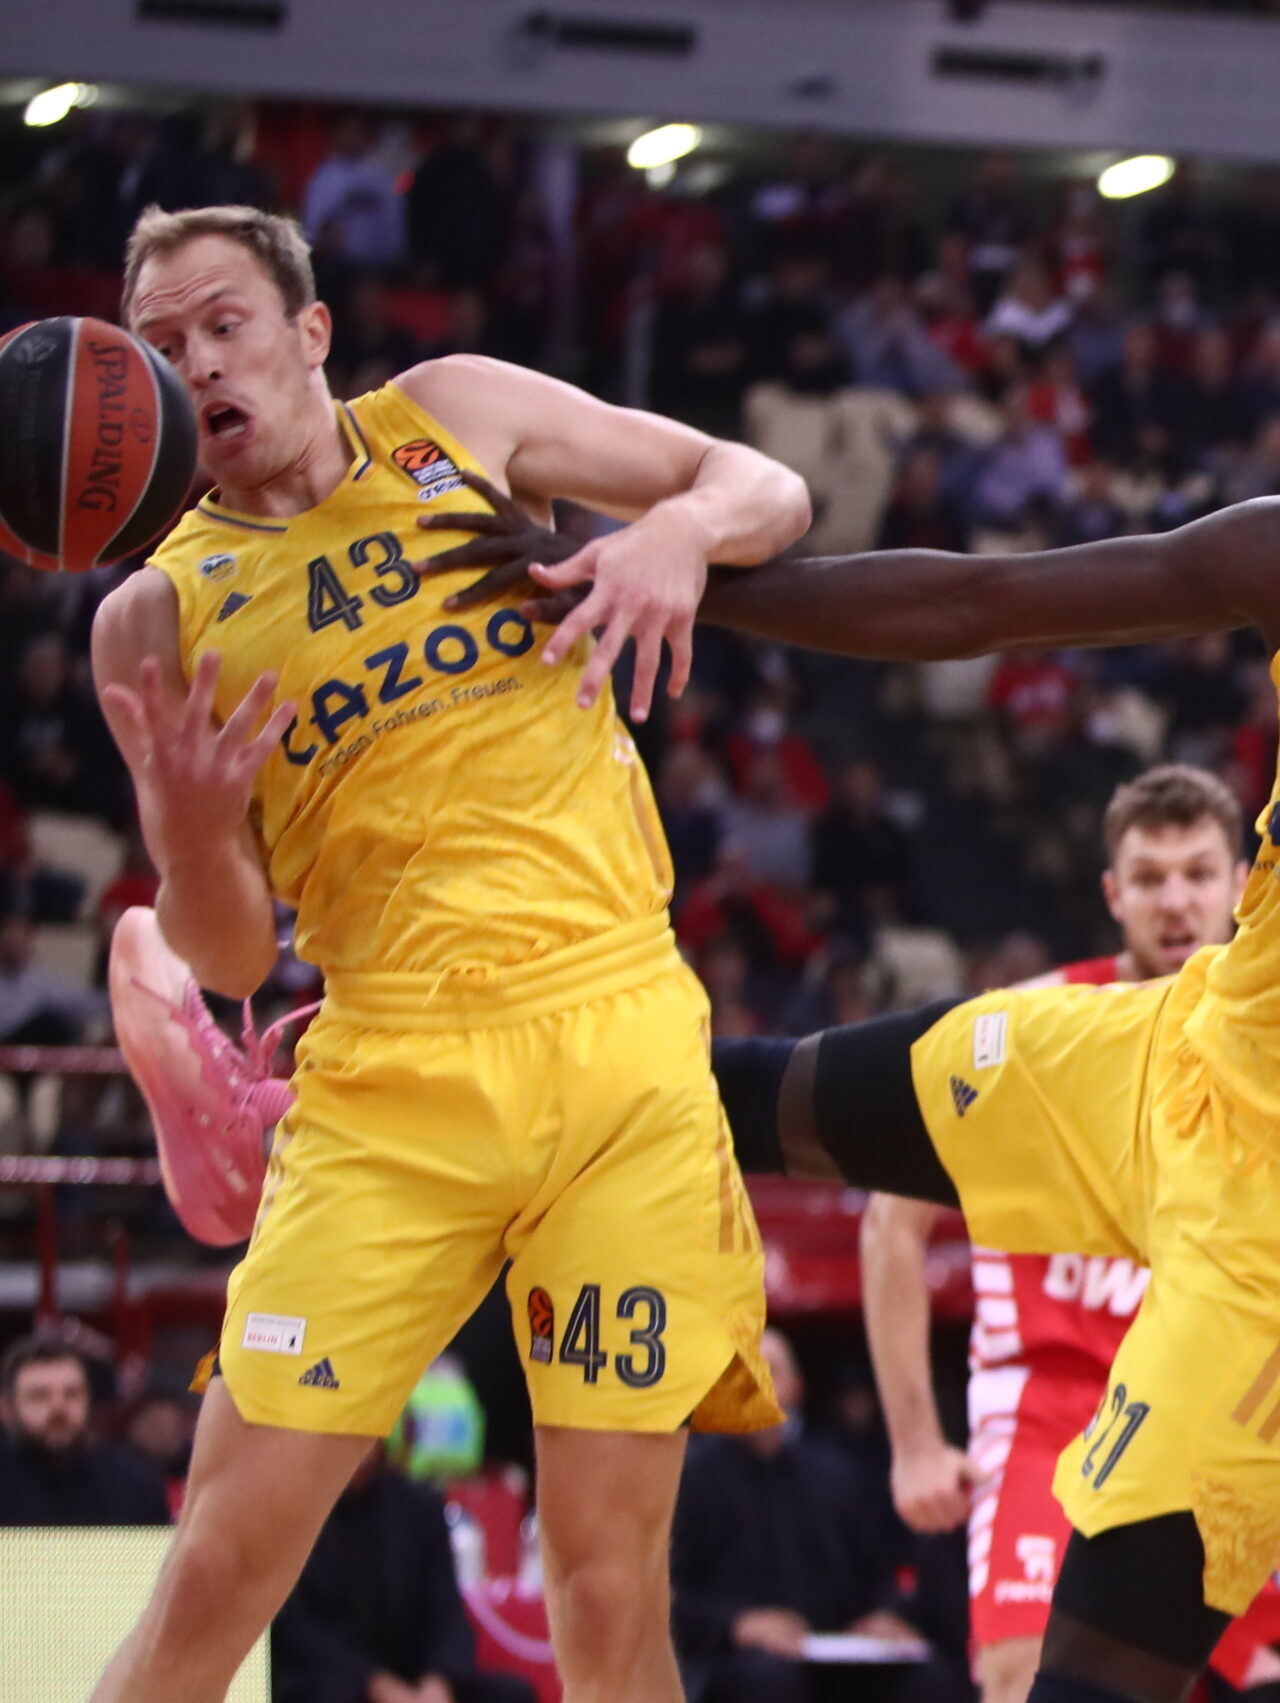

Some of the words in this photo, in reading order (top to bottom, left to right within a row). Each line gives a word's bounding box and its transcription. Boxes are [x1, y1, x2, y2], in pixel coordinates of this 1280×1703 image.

[80, 341, 129, 513] SPALDING
[307, 530, 421, 632] 43
[559, 1283, 667, 1389] 43
[1081, 1383, 1150, 1491] 21
